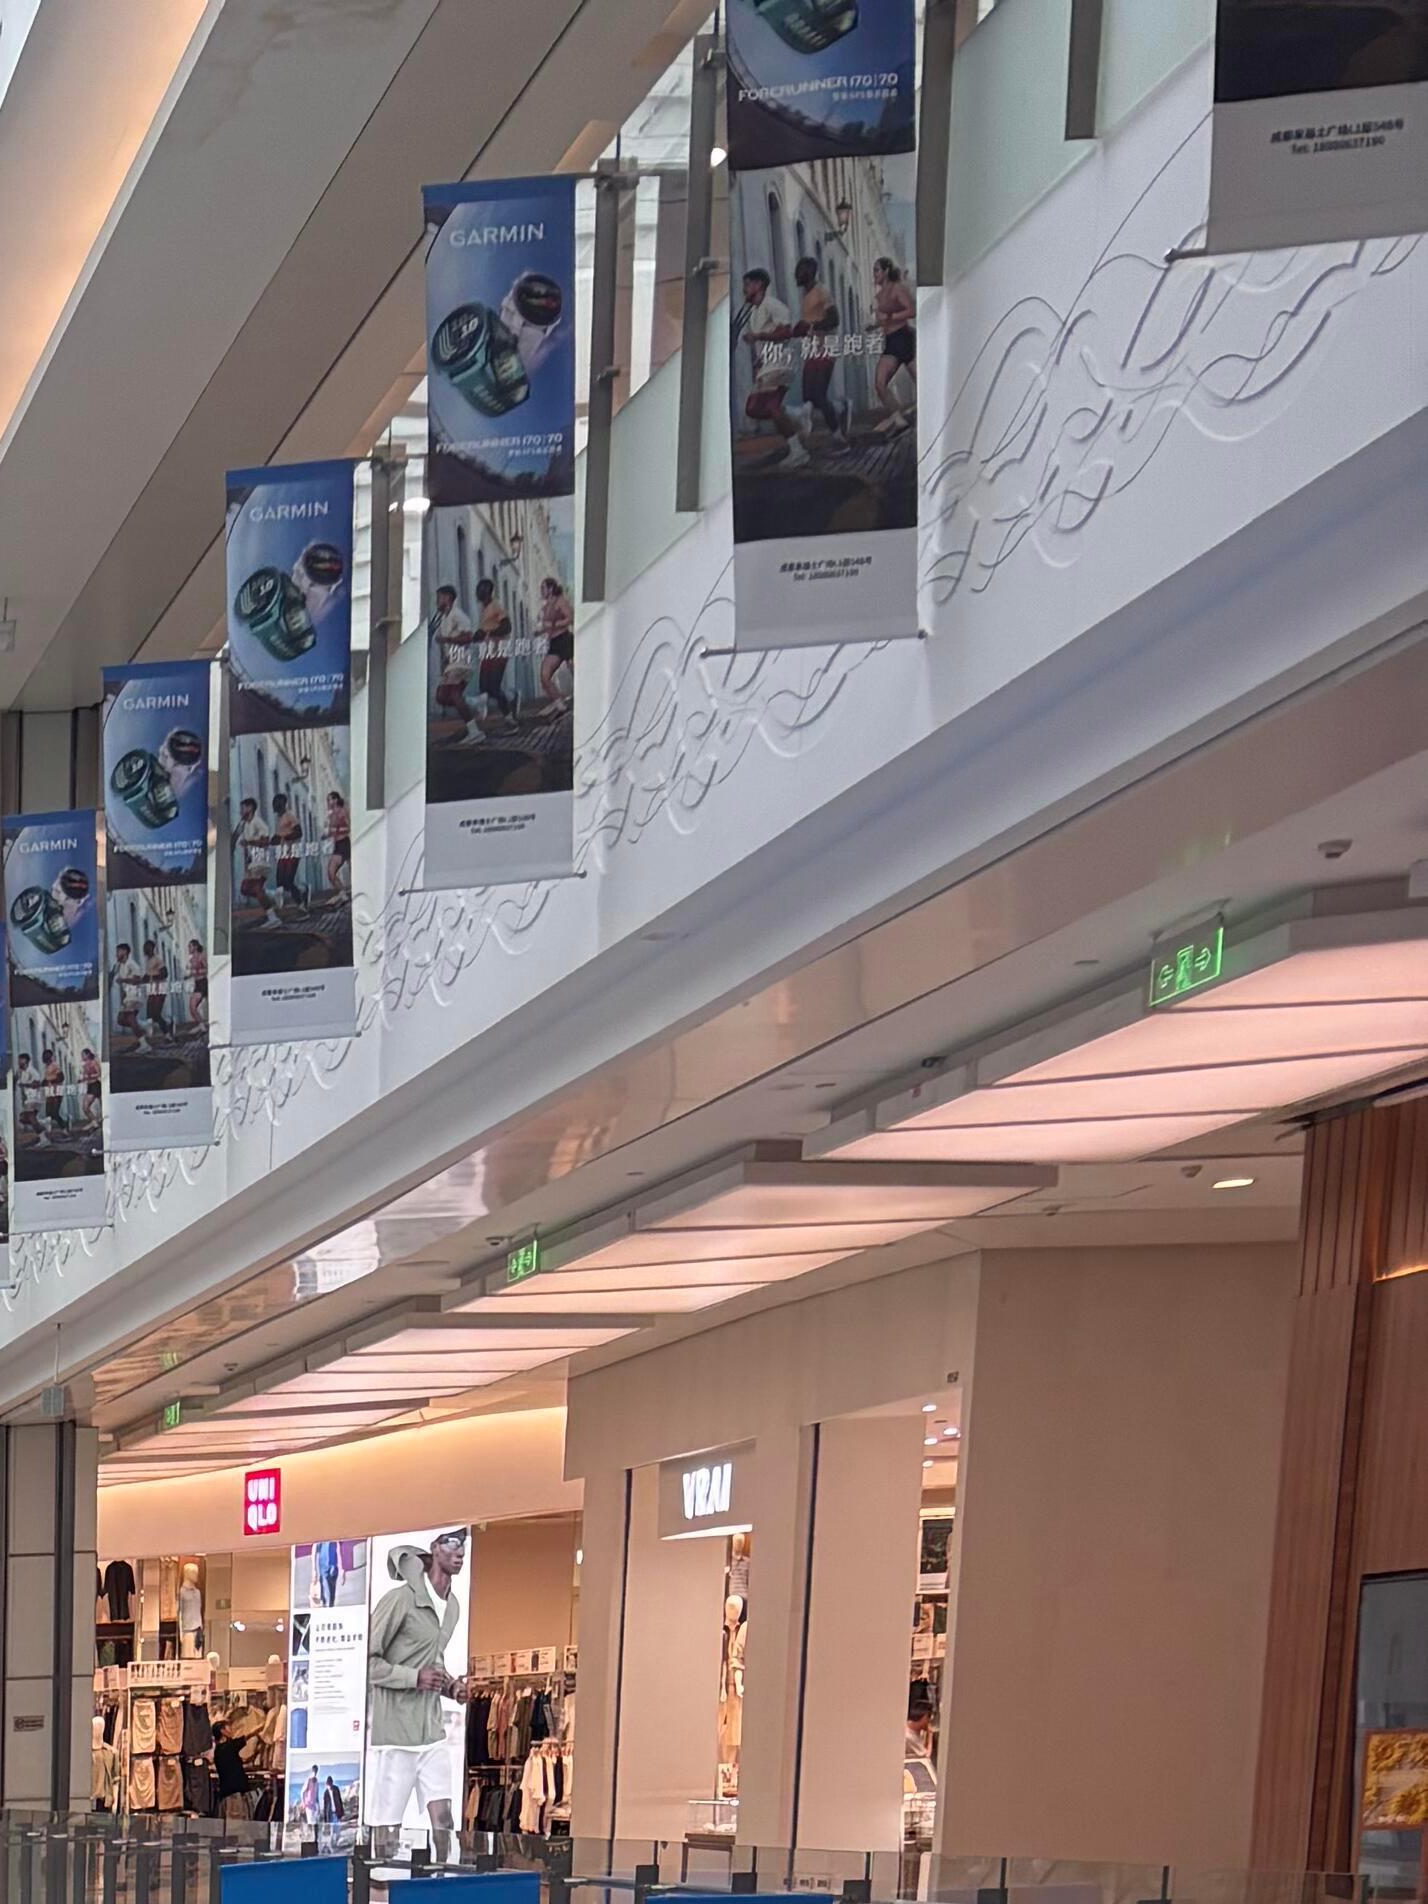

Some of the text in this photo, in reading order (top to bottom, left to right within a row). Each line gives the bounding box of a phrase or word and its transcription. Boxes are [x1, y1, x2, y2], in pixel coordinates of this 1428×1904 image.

[449, 224, 544, 247] GARMIN
[250, 500, 329, 523] GARMIN
[123, 693, 189, 709] GARMIN
[248, 1477, 275, 1502] UNI
[248, 1502, 277, 1531] QLO
